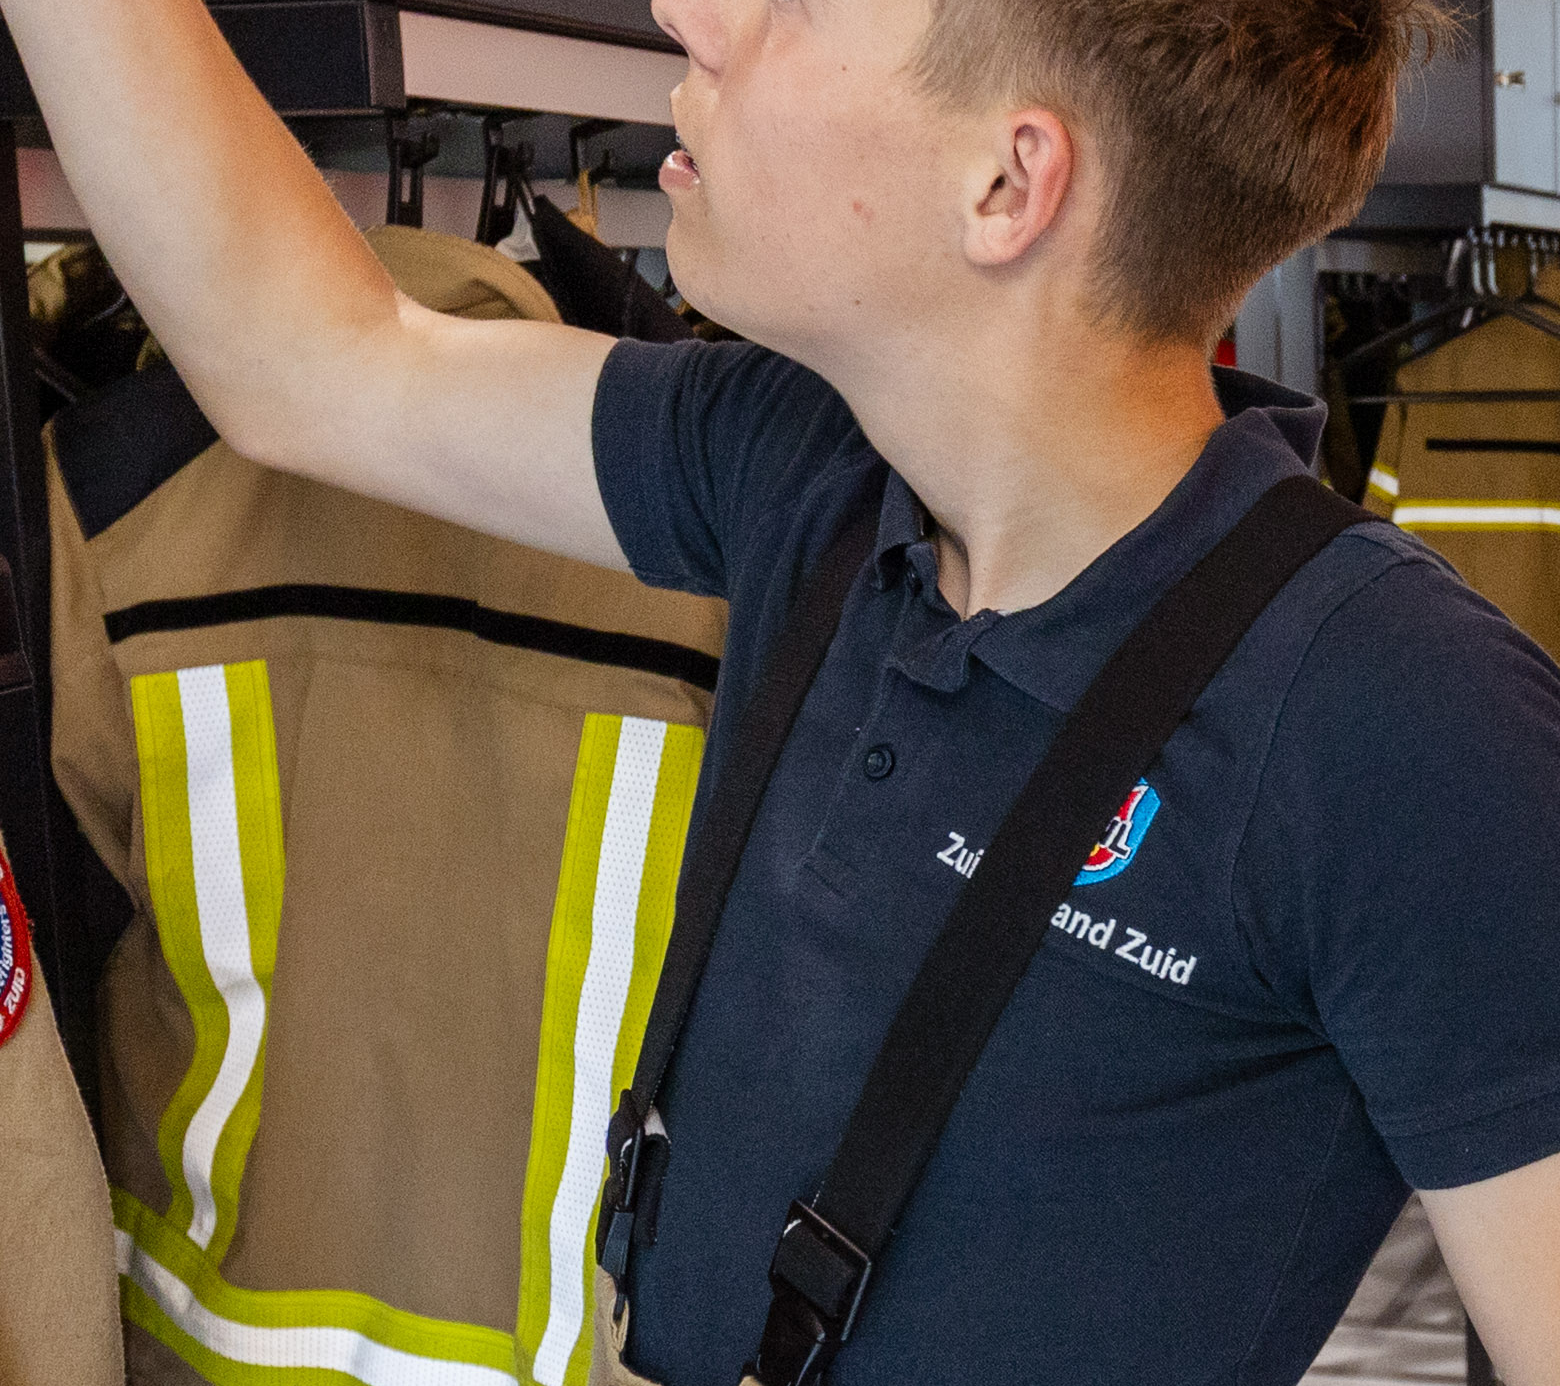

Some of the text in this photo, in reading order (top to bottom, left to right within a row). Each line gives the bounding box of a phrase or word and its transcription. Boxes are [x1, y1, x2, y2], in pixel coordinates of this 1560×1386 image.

[937, 831, 1198, 985] Zui and Zuid
[3, 966, 26, 1015] ZUID
